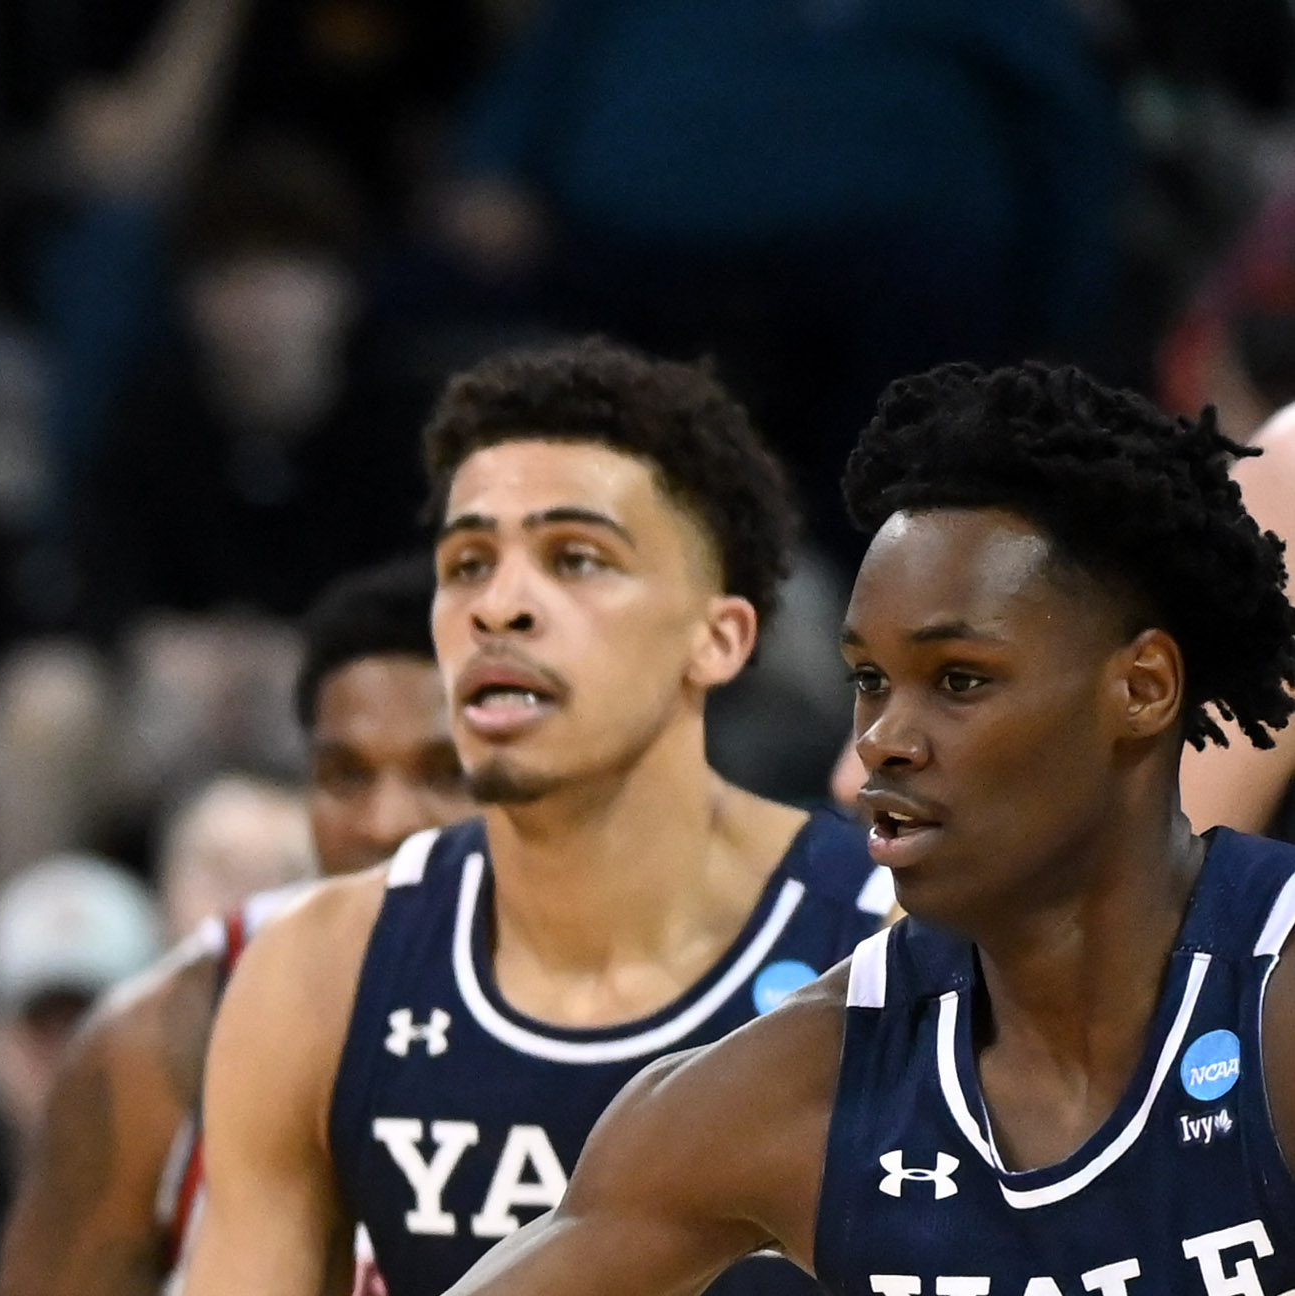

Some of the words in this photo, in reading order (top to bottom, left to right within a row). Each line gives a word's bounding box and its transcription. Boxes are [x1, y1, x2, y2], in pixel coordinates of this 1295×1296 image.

[1189, 1058, 1240, 1086] NCAA
[1179, 1114, 1214, 1145] Ivy
[372, 1116, 569, 1238] YA
